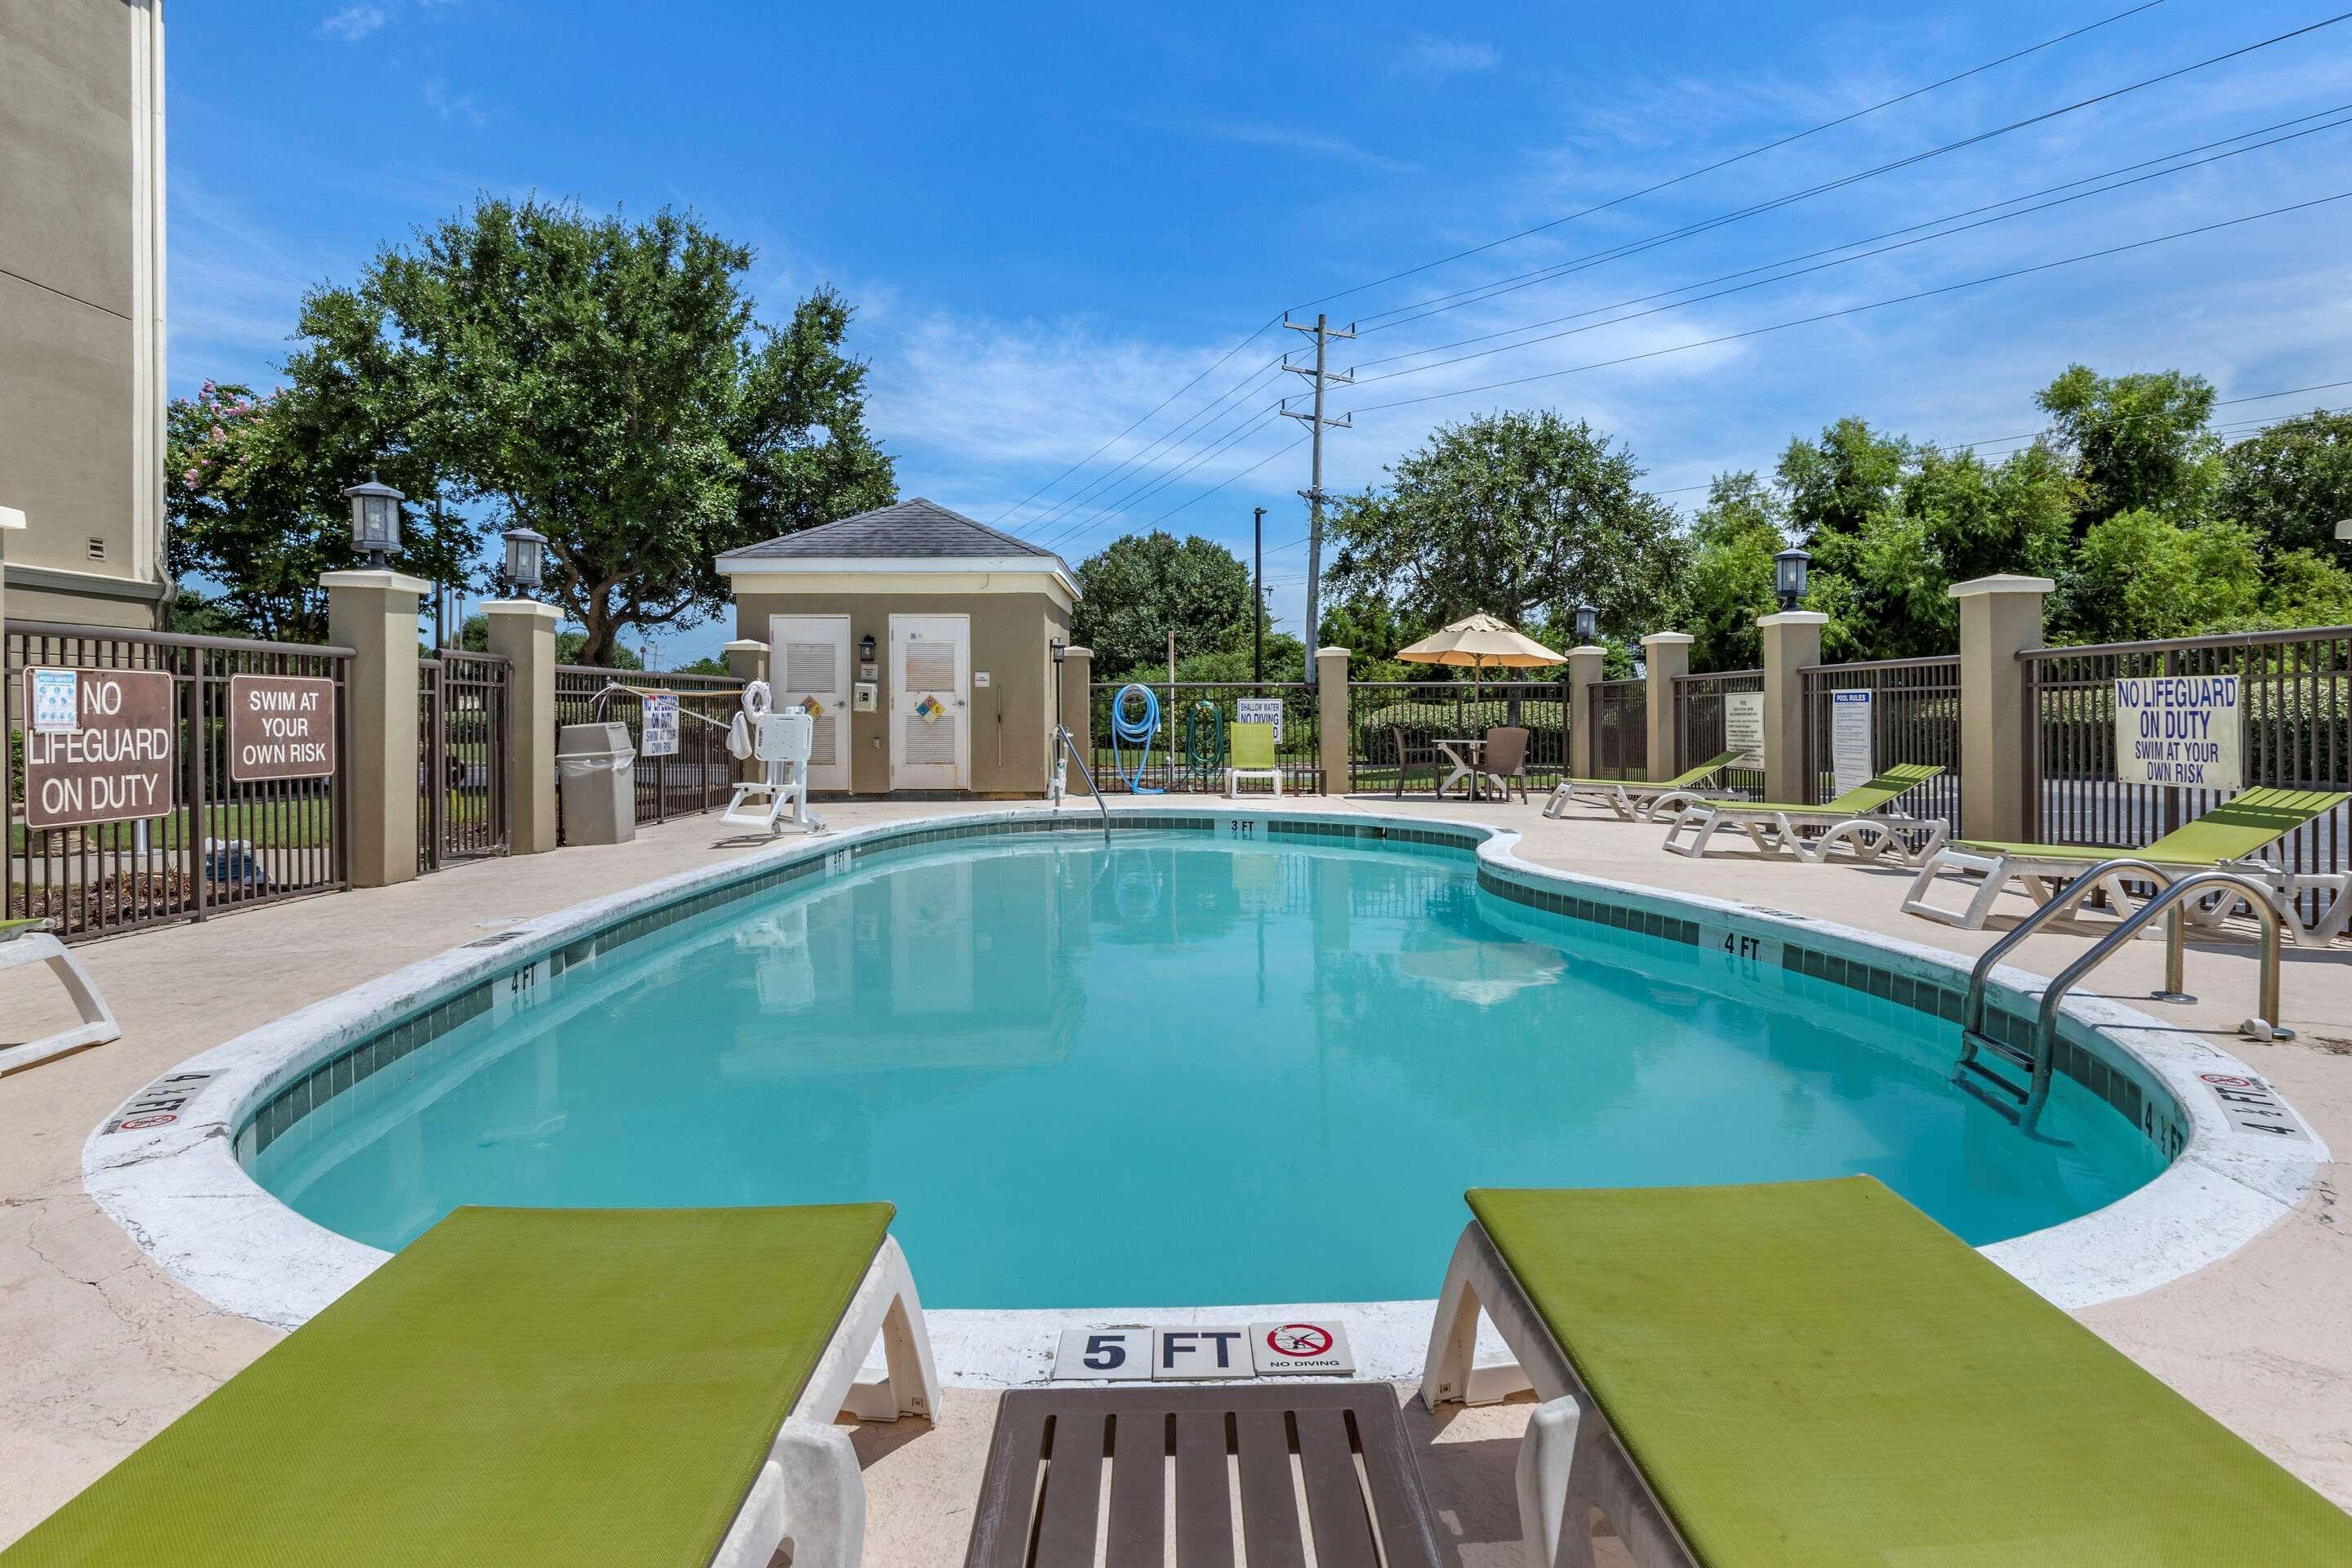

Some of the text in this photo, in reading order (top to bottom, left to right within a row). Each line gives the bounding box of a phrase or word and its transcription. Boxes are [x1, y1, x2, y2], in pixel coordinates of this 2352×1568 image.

[83, 681, 122, 715] NO
[249, 690, 319, 711] SWIM AT
[1837, 694, 1848, 702] POOL
[2118, 677, 2236, 708] NO LIFEGUARD
[1241, 702, 1280, 711] SHALLOW WATER
[261, 717, 309, 737] YOUR
[652, 712, 672, 728] ON DUTY
[1241, 713, 1279, 725] NO DIVING
[2140, 710, 2211, 739] ON DUTY
[28, 728, 169, 764] LIFEGUARD
[646, 730, 659, 742] SWIM
[660, 729, 665, 741] AT
[243, 742, 327, 765] OWN RISK
[652, 742, 662, 754] OWN
[2135, 740, 2219, 763] SWIM AT YOUR
[2147, 761, 2204, 784] OWN RISK
[42, 773, 159, 815] ON DUTY
[1231, 820, 1254, 831] 3 FT
[1724, 933, 1760, 960] 4 FT
[511, 961, 537, 995] 4 FT
[2214, 1086, 2275, 1107] FT
[2145, 1101, 2153, 1138] 4
[2170, 1123, 2183, 1165] FT
[2240, 1121, 2296, 1136] 4
[1083, 1332, 1241, 1370] 5 FT
[1270, 1359, 1340, 1368] NO DIVING
